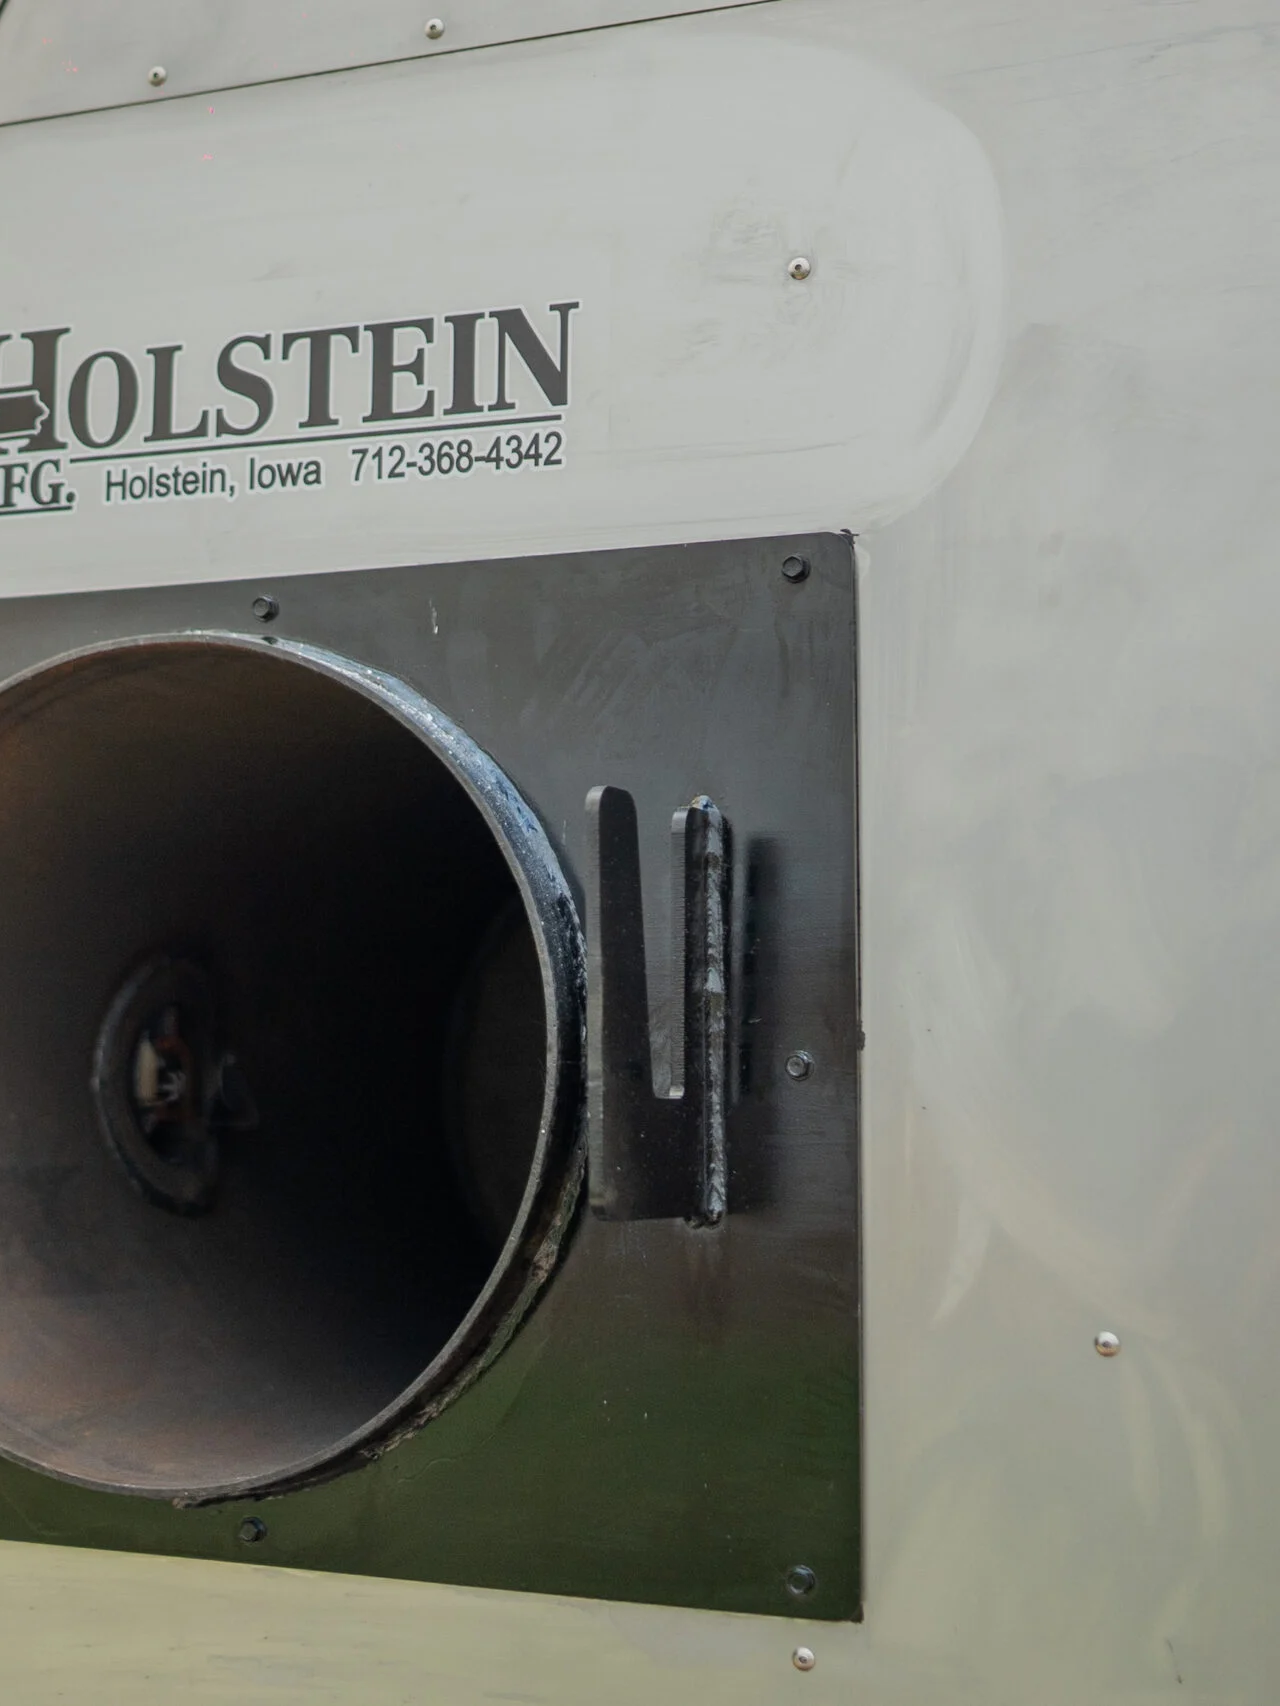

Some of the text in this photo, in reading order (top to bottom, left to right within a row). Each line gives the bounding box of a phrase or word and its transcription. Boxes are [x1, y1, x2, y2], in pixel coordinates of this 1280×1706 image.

[106, 461, 235, 502] Holstein,
[249, 457, 322, 490] Iowa
[351, 431, 563, 482] 712-368-4342
